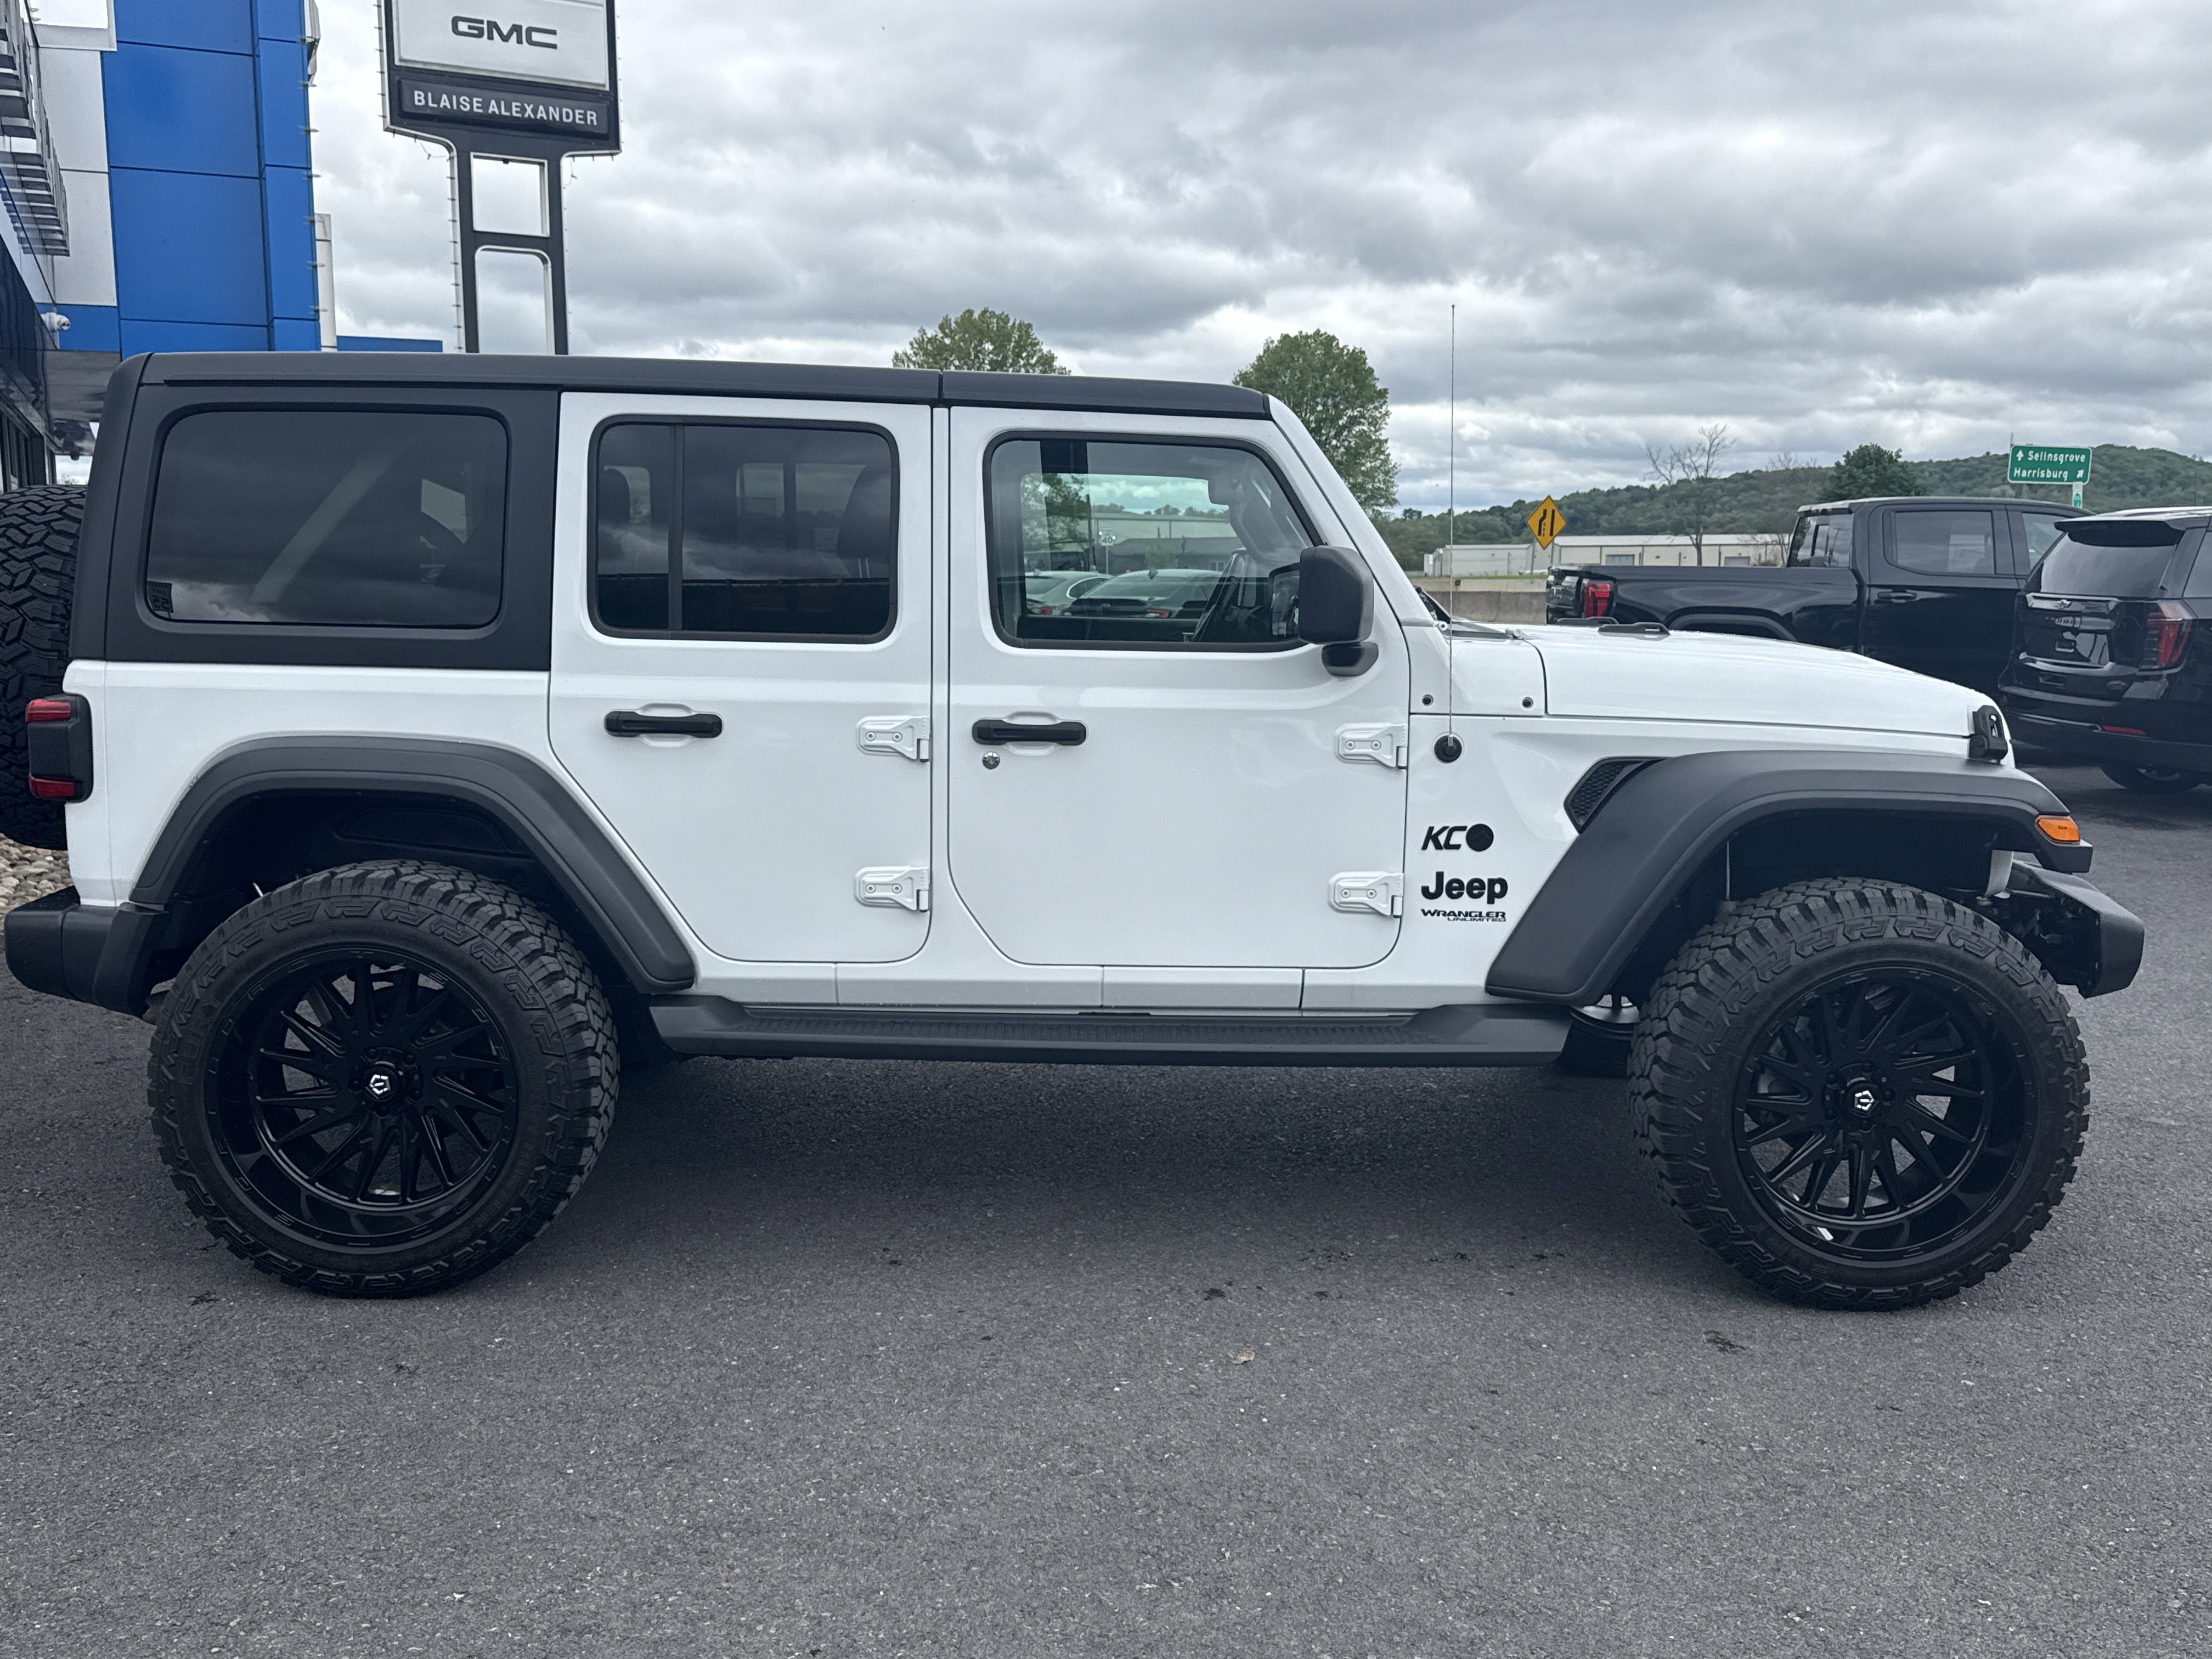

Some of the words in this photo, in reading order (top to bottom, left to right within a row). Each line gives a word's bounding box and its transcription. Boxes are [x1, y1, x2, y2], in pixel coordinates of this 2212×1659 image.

[452, 15, 557, 49] GMC
[414, 91, 483, 113] BLAISE
[488, 100, 597, 126] ALEXANDER
[2028, 450, 2085, 464] Selinsgrove
[2013, 467, 2068, 481] Harrisburg
[1421, 871, 1508, 904] Jeep
[1421, 909, 1505, 918] WRANGLER
